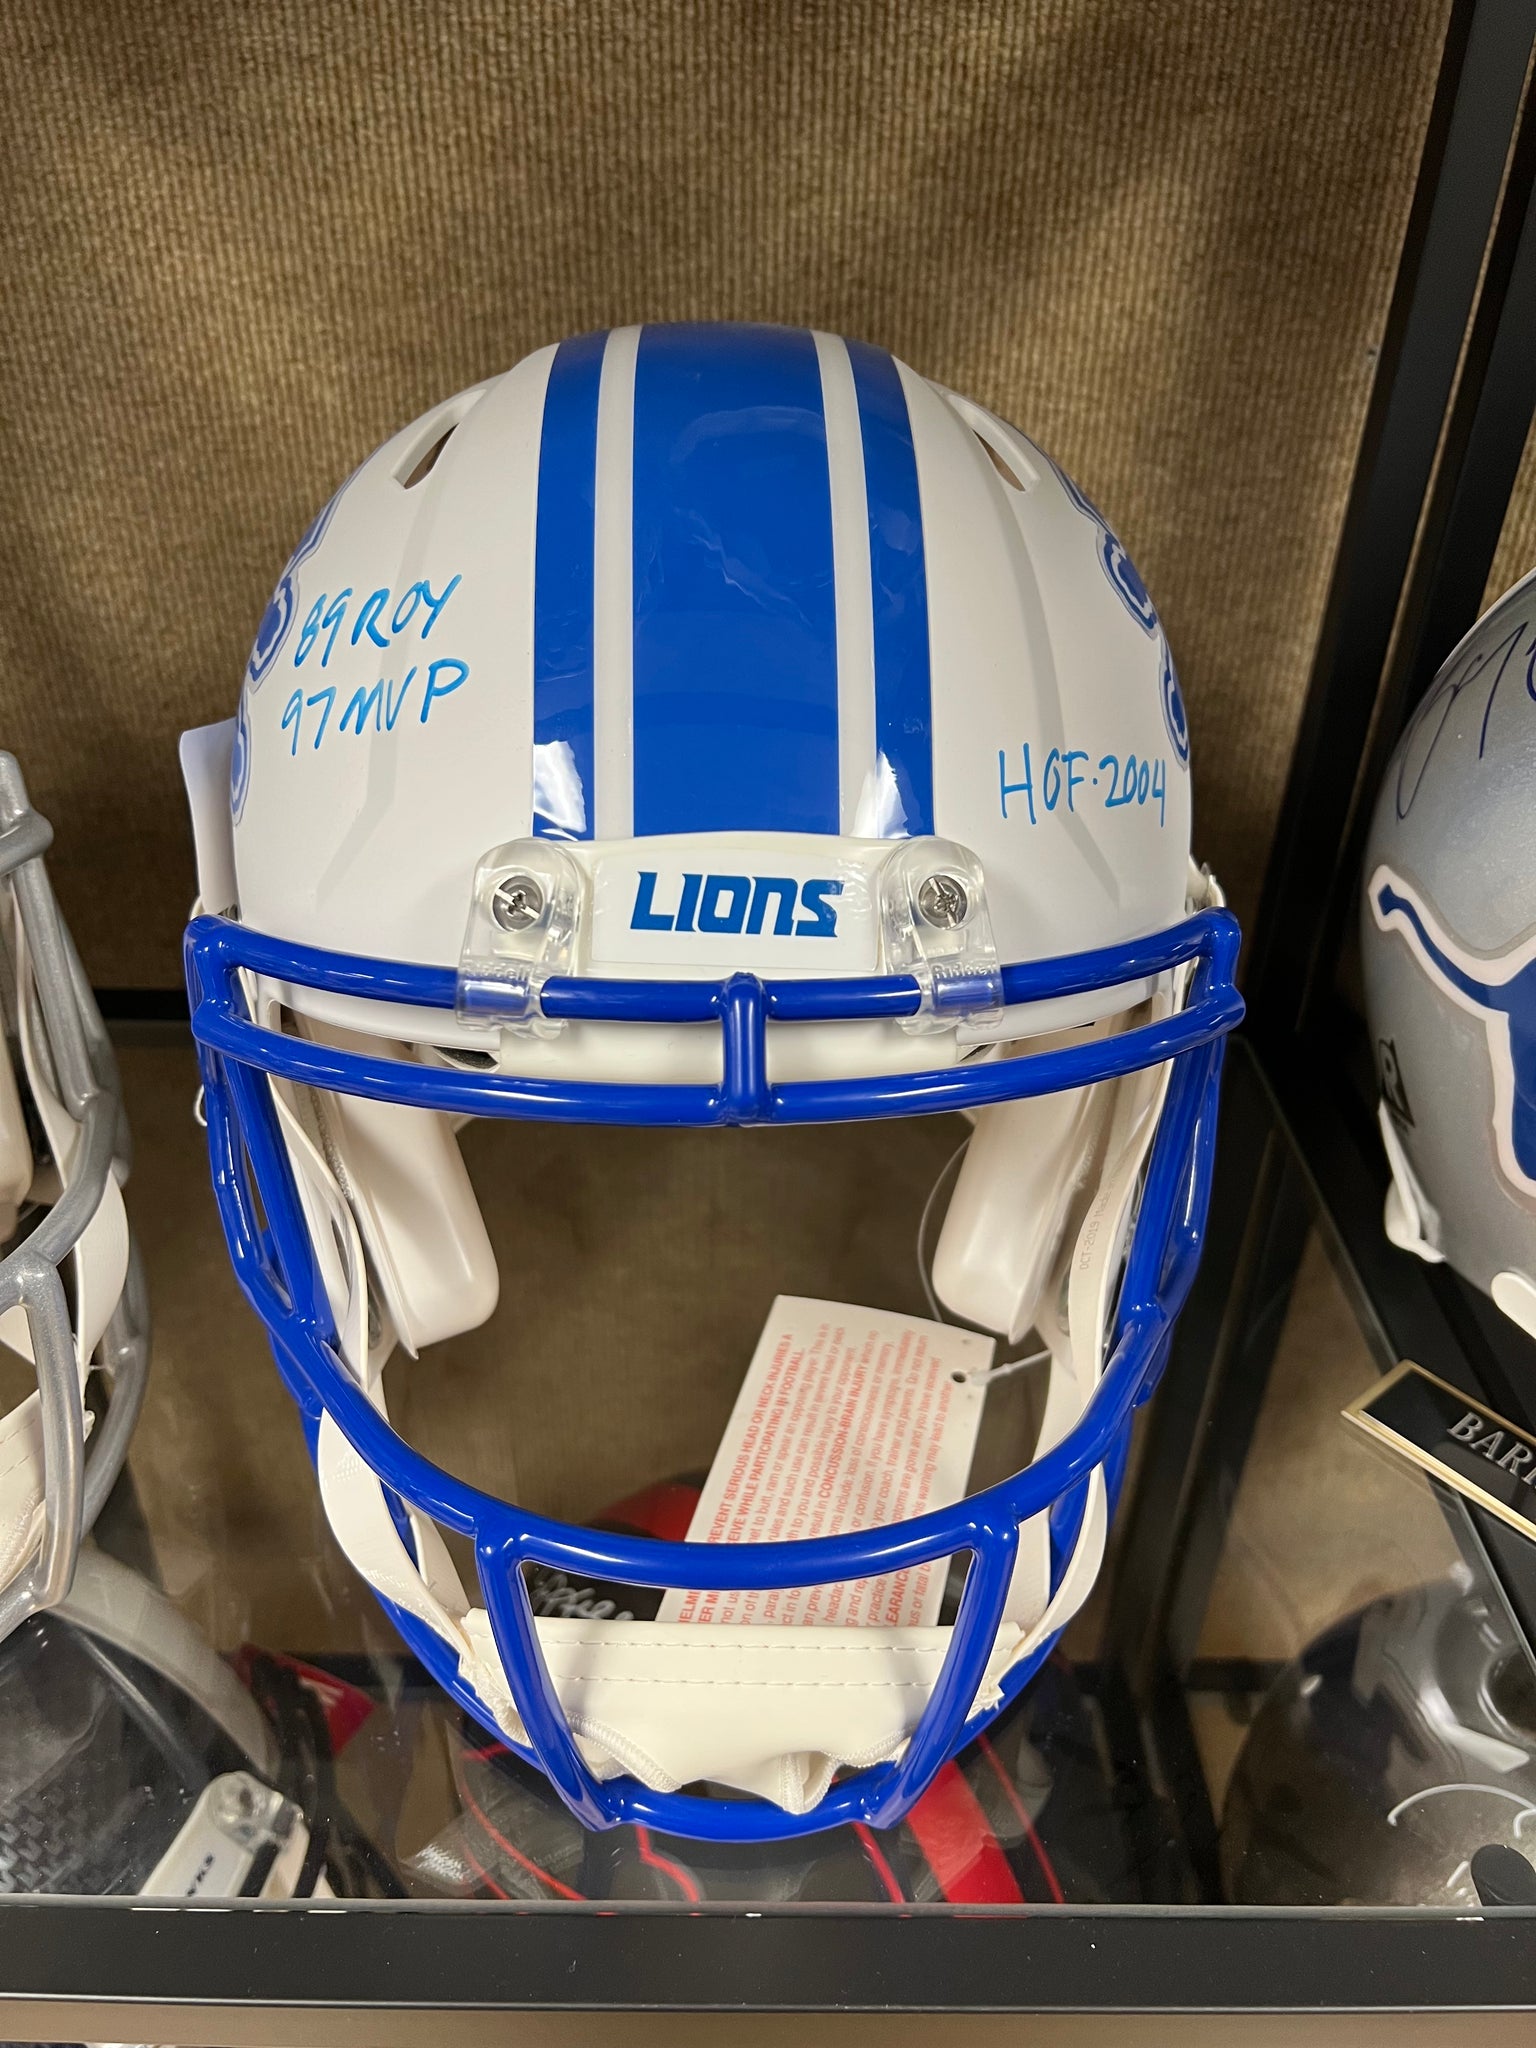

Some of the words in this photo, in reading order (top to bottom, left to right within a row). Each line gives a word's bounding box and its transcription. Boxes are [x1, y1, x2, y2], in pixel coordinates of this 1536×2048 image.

[350, 574, 463, 648] ROY
[280, 685, 337, 756] 97
[338, 657, 471, 735] MVP
[629, 870, 845, 938] LIONS
[765, 1340, 789, 1380] INJURIES
[848, 1364, 868, 1397] INJURY
[756, 1380, 775, 1407] NECK
[787, 1382, 810, 1421] opposing
[829, 1386, 845, 1404] your
[918, 1392, 932, 1412] have
[750, 1409, 765, 1423] OR
[808, 1403, 821, 1411] in
[826, 1406, 838, 1414] to
[933, 1412, 946, 1421] to
[783, 1422, 797, 1434] an
[800, 1412, 818, 1436] result
[818, 1415, 835, 1439] injury
[873, 1421, 888, 1441] have
[892, 1419, 907, 1437] and
[913, 1412, 927, 1429] you
[739, 1425, 759, 1452] HEAD
[909, 1430, 923, 1448] and
[928, 1422, 944, 1441] lead
[774, 1434, 793, 1460] spear
[794, 1437, 810, 1454] can
[818, 1398, 858, 1498] CONCUSSION-BRAIN
[868, 1443, 883, 1459] you
[885, 1438, 902, 1466] trainer
[923, 1442, 939, 1462] may
[770, 1461, 784, 1471] or
[789, 1455, 804, 1471] use
[806, 1439, 828, 1477] possible
[903, 1448, 918, 1472] gone
[722, 1454, 749, 1500] SERIOUS
[726, 1518, 746, 1544] EIVE
[736, 1482, 758, 1514] WHILE
[748, 1408, 784, 1480] PARTICIPATING
[774, 1396, 788, 1406] IN
[899, 1472, 913, 1488] are
[763, 1473, 780, 1491] ram
[781, 1473, 798, 1495] such
[800, 1479, 816, 1496] and
[914, 1463, 934, 1499] warning
[774, 1497, 790, 1516] and
[793, 1498, 810, 1516] you
[814, 1500, 828, 1508] in
[870, 1500, 886, 1521] your
[706, 1502, 732, 1543] REVENT
[752, 1516, 766, 1525] to
[766, 1518, 784, 1540] rules
[790, 1518, 804, 1527] to
[805, 1585, 824, 1611] prev
[850, 1446, 863, 1455] of
[806, 1509, 825, 1536] result
[849, 1517, 863, 1527] or
[911, 1574, 928, 1595] fatal
[678, 1591, 700, 1621] ELM
[743, 1601, 757, 1610] of
[761, 1589, 782, 1617] paral
[823, 1583, 845, 1621] headac
[845, 1595, 862, 1615] and
[865, 1578, 887, 1621] practice
[884, 1569, 910, 1624] EARANC
[908, 1597, 923, 1608] or
